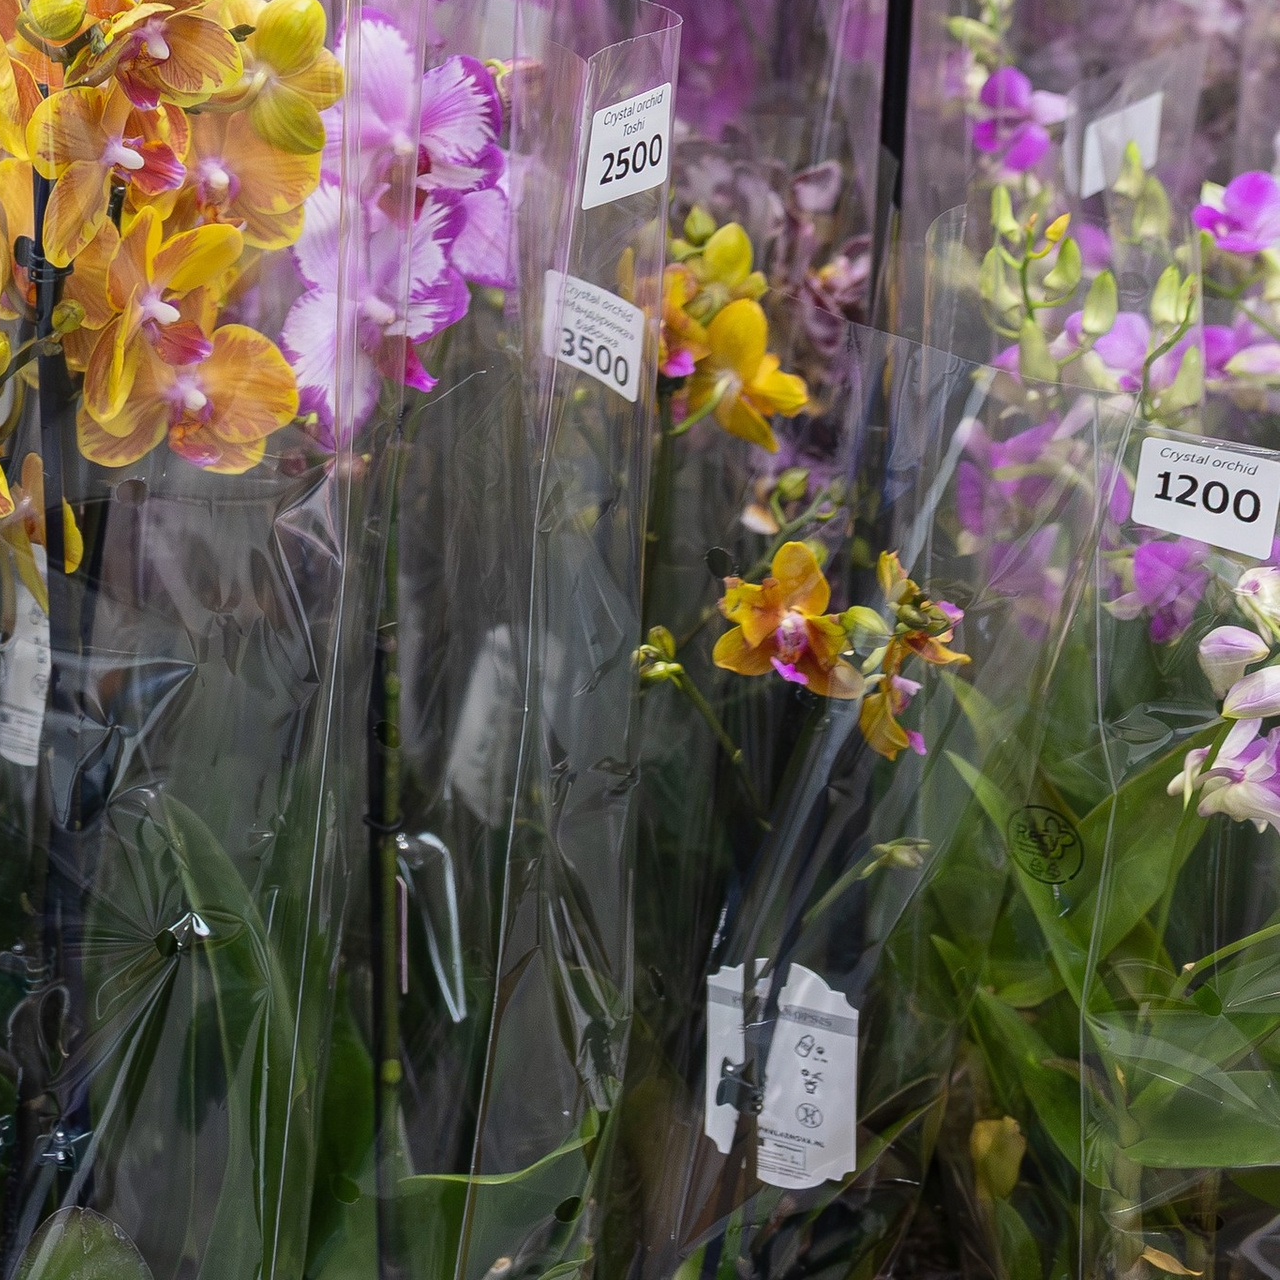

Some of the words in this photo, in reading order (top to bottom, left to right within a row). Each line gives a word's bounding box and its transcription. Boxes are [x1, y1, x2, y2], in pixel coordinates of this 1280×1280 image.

[603, 101, 636, 127] Crystal
[636, 89, 664, 113] orchid
[622, 116, 646, 137] Toshi
[599, 133, 663, 186] 2500
[561, 327, 629, 387] 3500
[1160, 447, 1210, 465] Crystal
[1211, 458, 1259, 476] orchid
[1154, 471, 1261, 524] 1200
